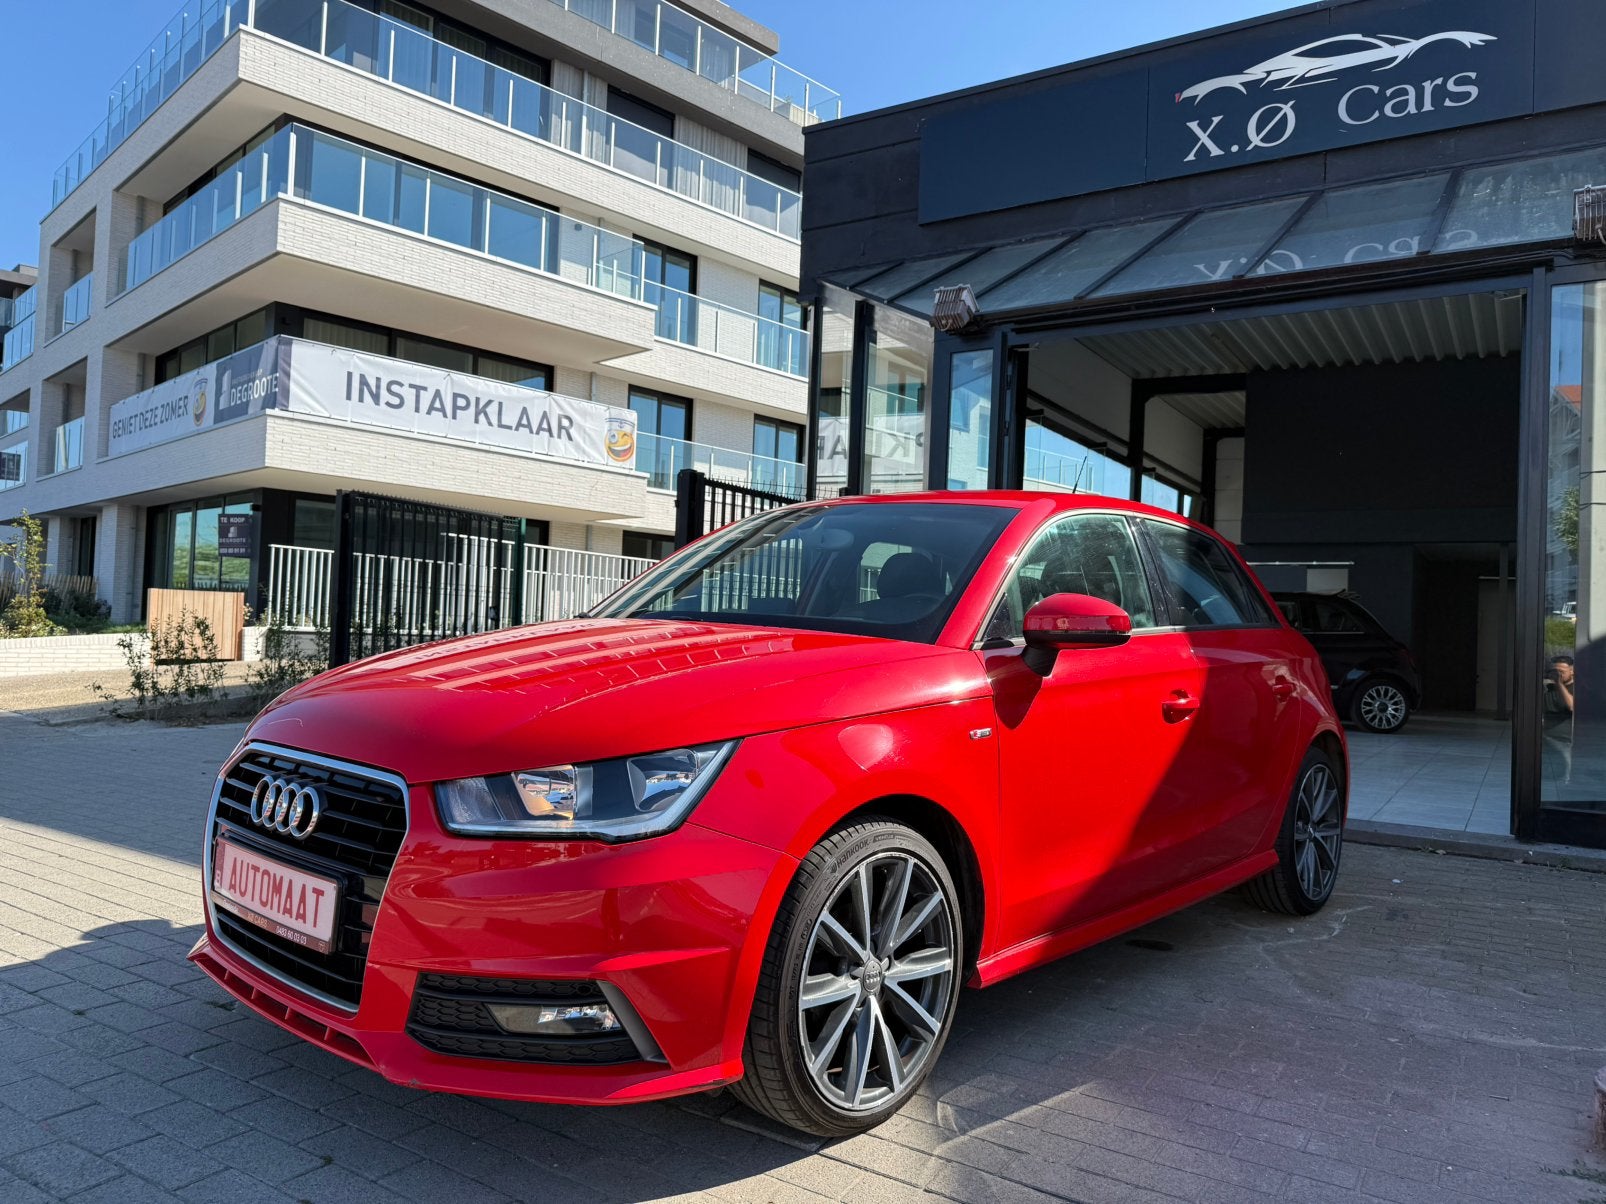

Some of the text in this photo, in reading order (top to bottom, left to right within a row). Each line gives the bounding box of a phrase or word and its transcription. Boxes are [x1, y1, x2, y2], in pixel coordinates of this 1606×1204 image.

[1337, 71, 1480, 126] Cars
[112, 395, 189, 439] GENIET DEZE ZOMER
[230, 373, 279, 407] DEGROOTE
[345, 371, 574, 442] INSTAPKLAAR
[228, 857, 325, 928] AUTOMAAT
